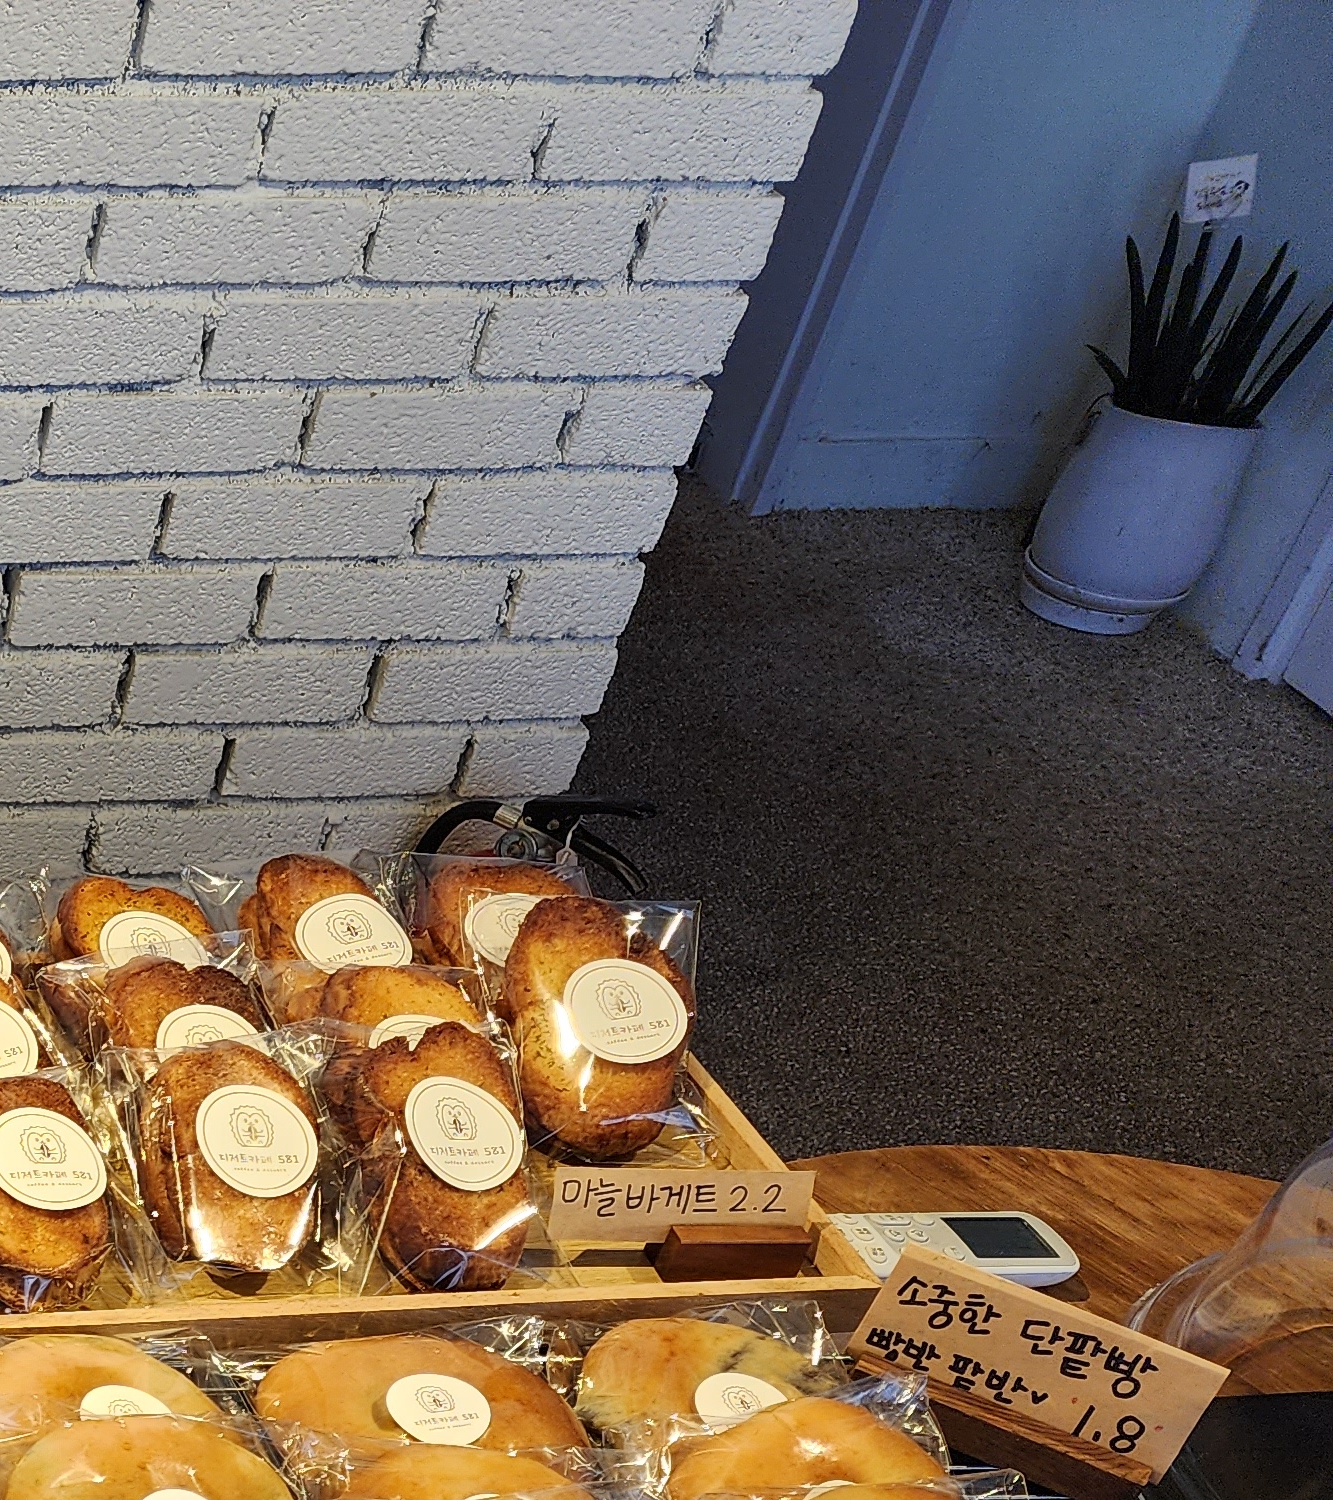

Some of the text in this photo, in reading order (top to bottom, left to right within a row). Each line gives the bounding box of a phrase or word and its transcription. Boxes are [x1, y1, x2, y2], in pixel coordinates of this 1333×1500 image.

[381, 941, 400, 950] 581
[648, 1019, 671, 1030] 581
[4, 1046, 23, 1058] 581
[484, 1146, 506, 1156] 581
[278, 1154, 300, 1164] 581
[72, 1170, 93, 1180] 581
[562, 1177, 787, 1218] 마늘바게트 2.2
[896, 1275, 1160, 1400] 소중한 단팥빵
[1070, 1404, 1147, 1454] 1.8
